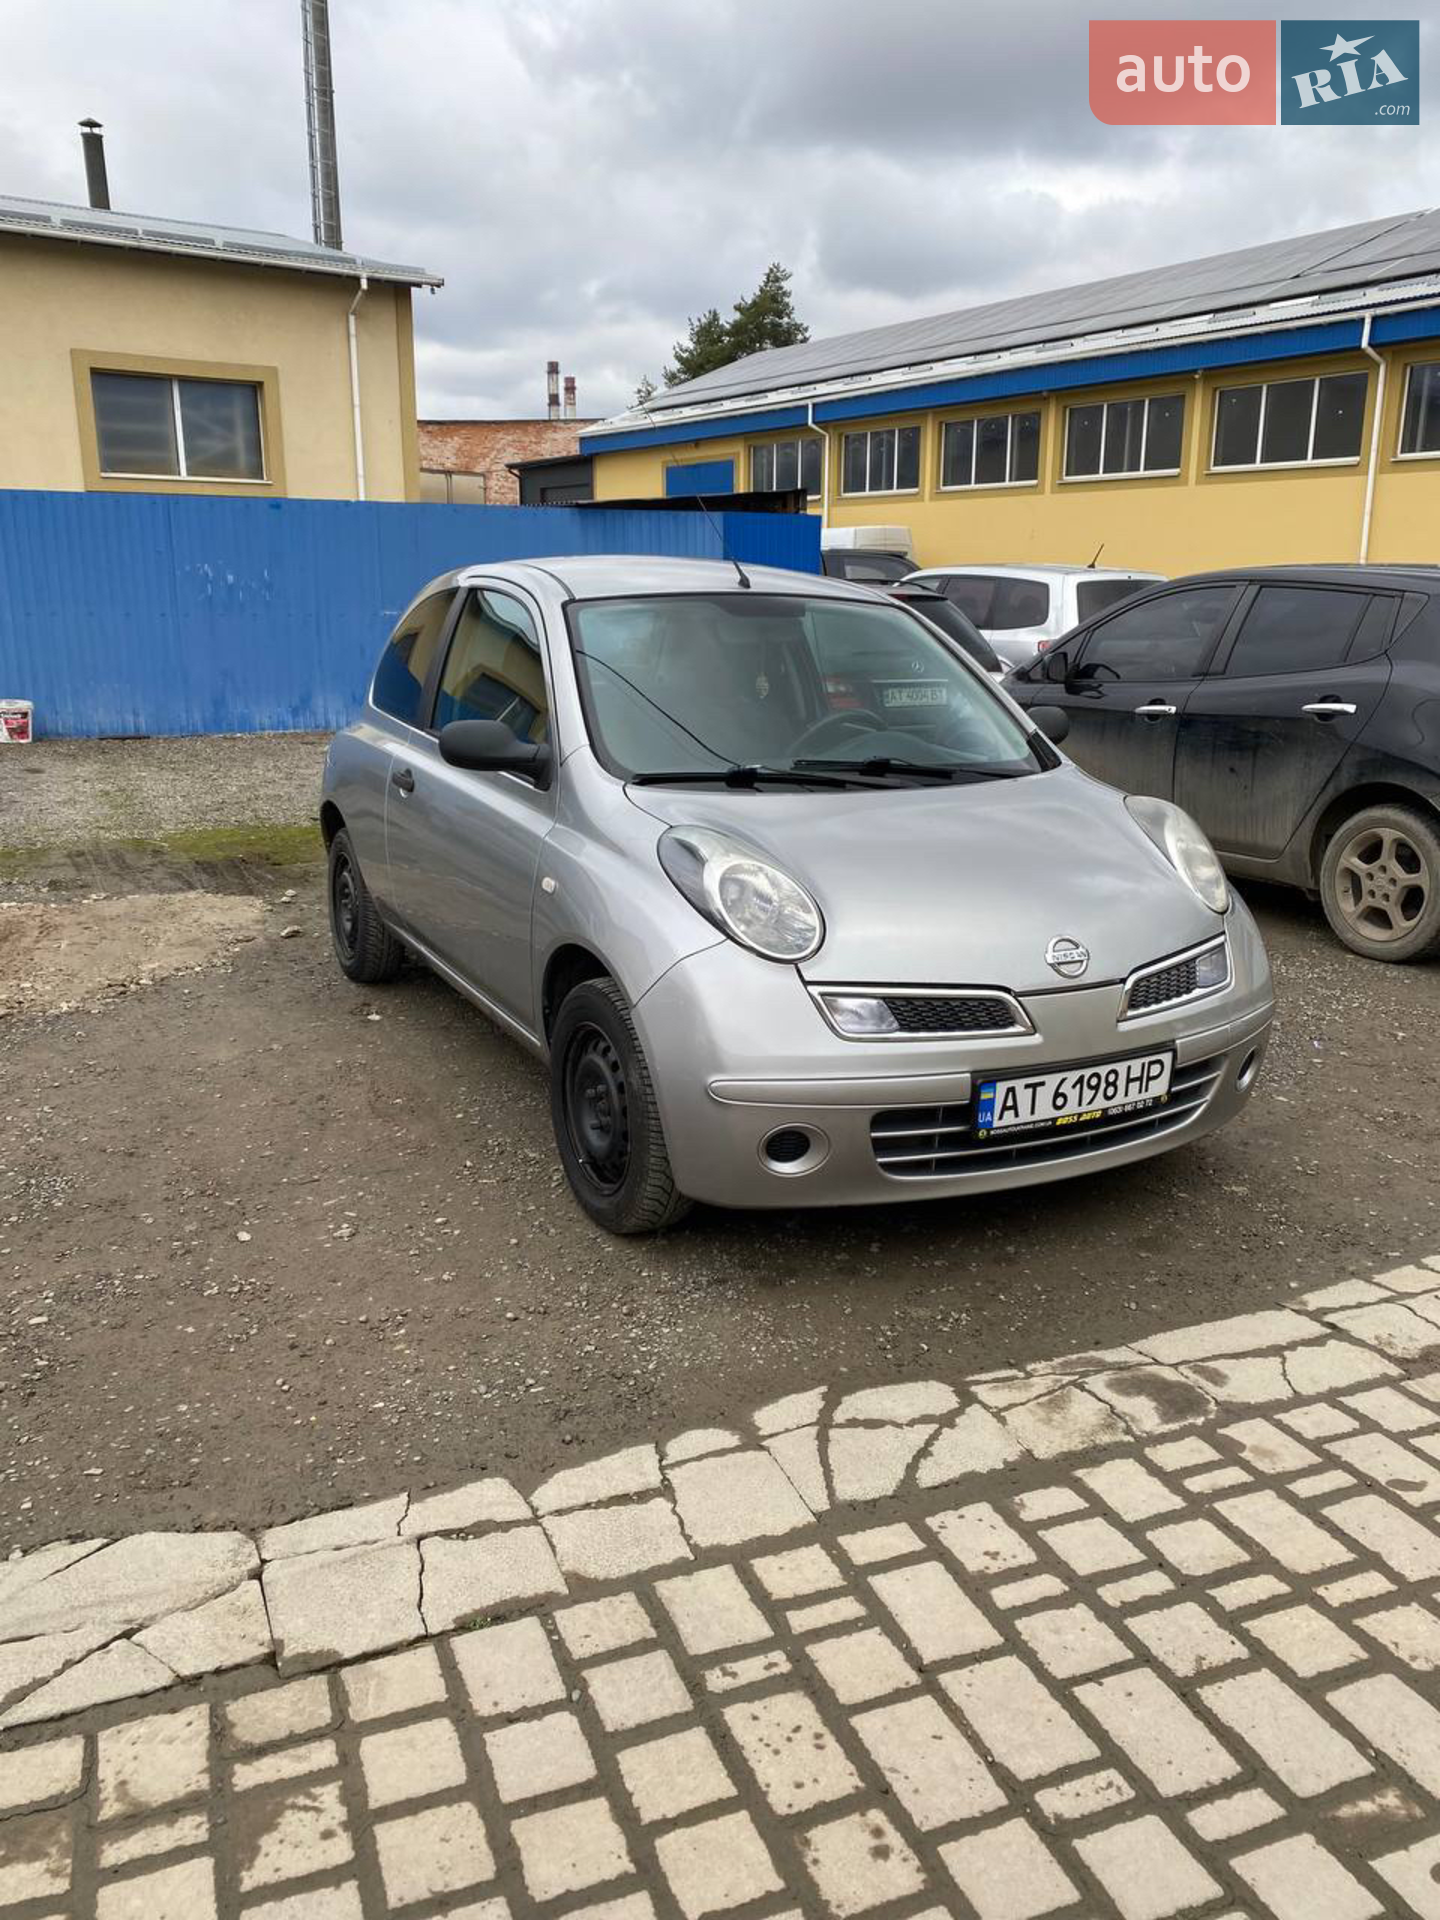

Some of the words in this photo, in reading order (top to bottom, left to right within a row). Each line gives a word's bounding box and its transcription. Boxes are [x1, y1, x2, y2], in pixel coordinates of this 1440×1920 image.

[998, 1080, 1046, 1121] AT
[1052, 1068, 1120, 1111] 6198
[1124, 1058, 1165, 1098] HP
[978, 1112, 992, 1124] UA
[1055, 1113, 1078, 1126] BOSS
[1079, 1109, 1103, 1122] AUTO
